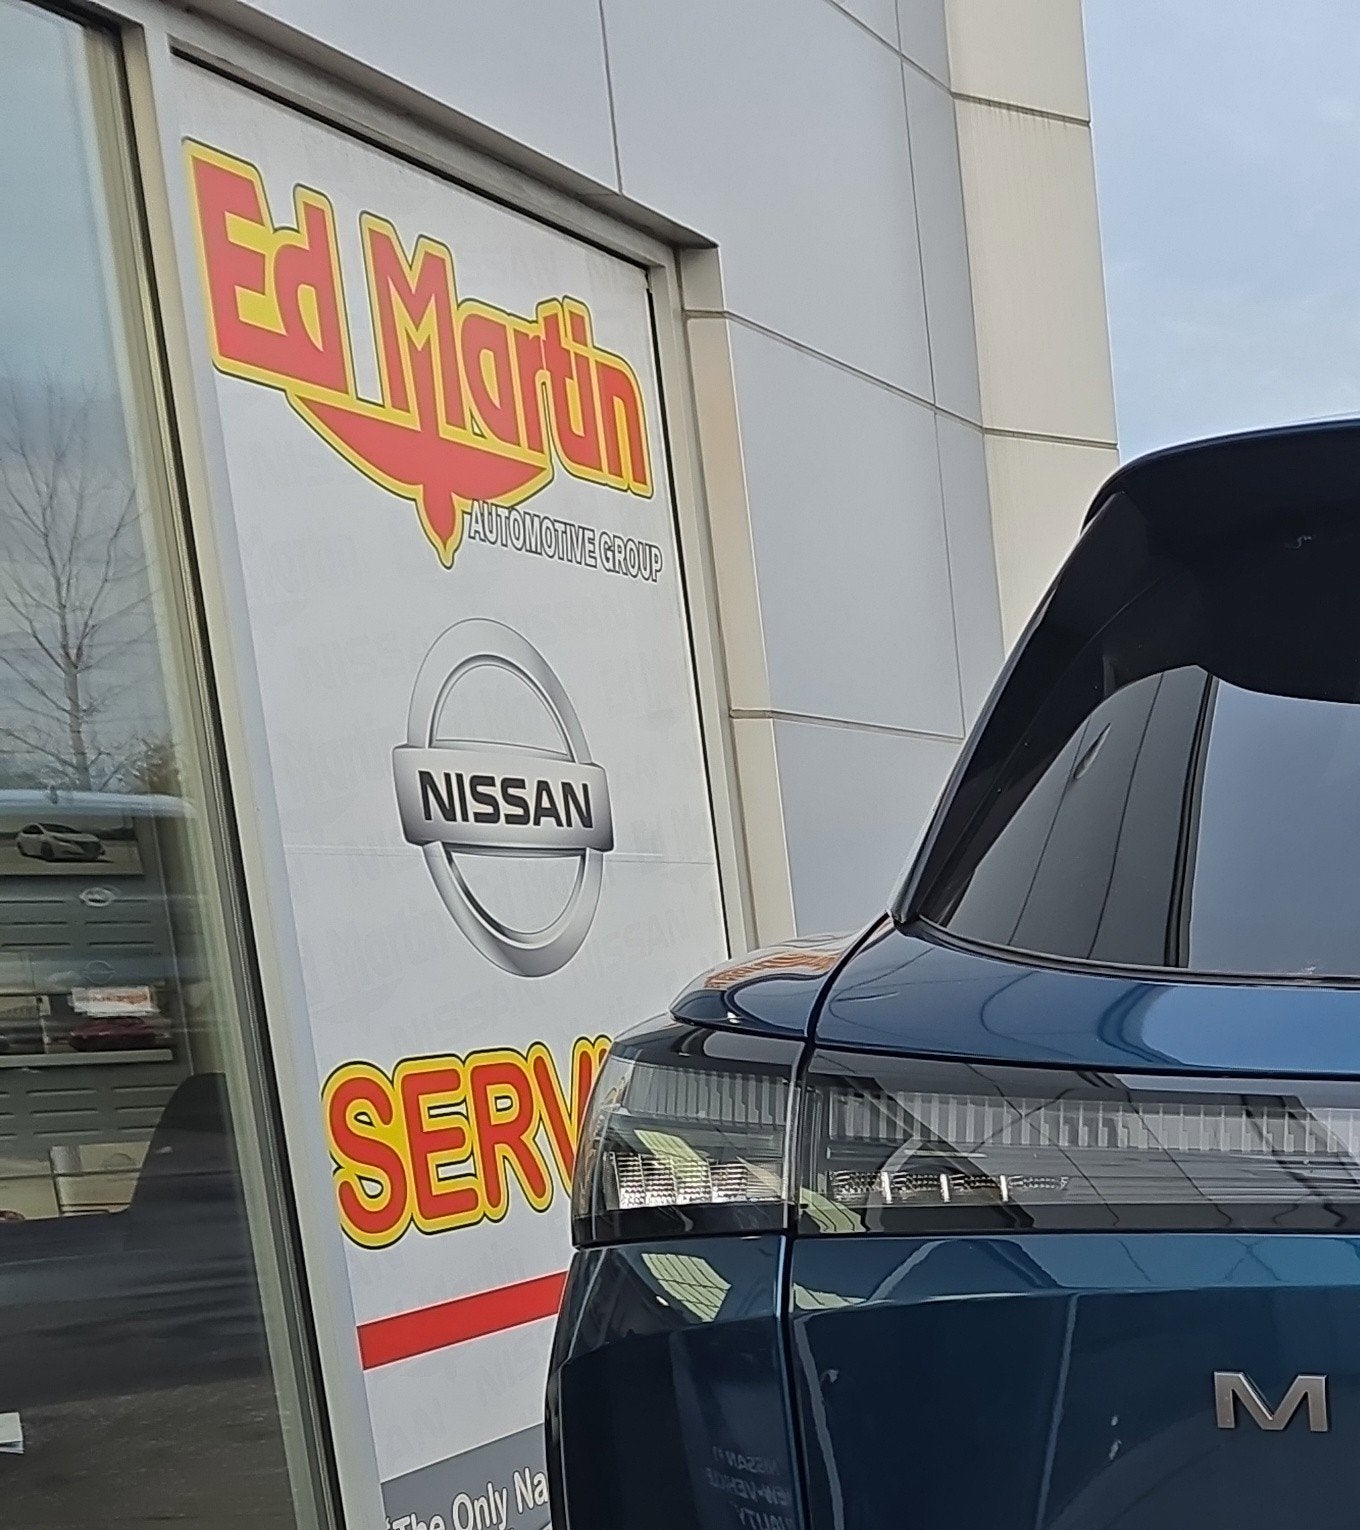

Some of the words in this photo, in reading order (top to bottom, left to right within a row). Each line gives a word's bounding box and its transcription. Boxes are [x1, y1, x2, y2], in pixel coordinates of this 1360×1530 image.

[184, 138, 358, 402] Ed
[360, 210, 653, 498] Martin
[467, 500, 598, 568] AUTOMOTIVE
[599, 531, 662, 582] GROUP
[418, 770, 594, 829] NISSAN
[321, 1035, 613, 1250] SERV
